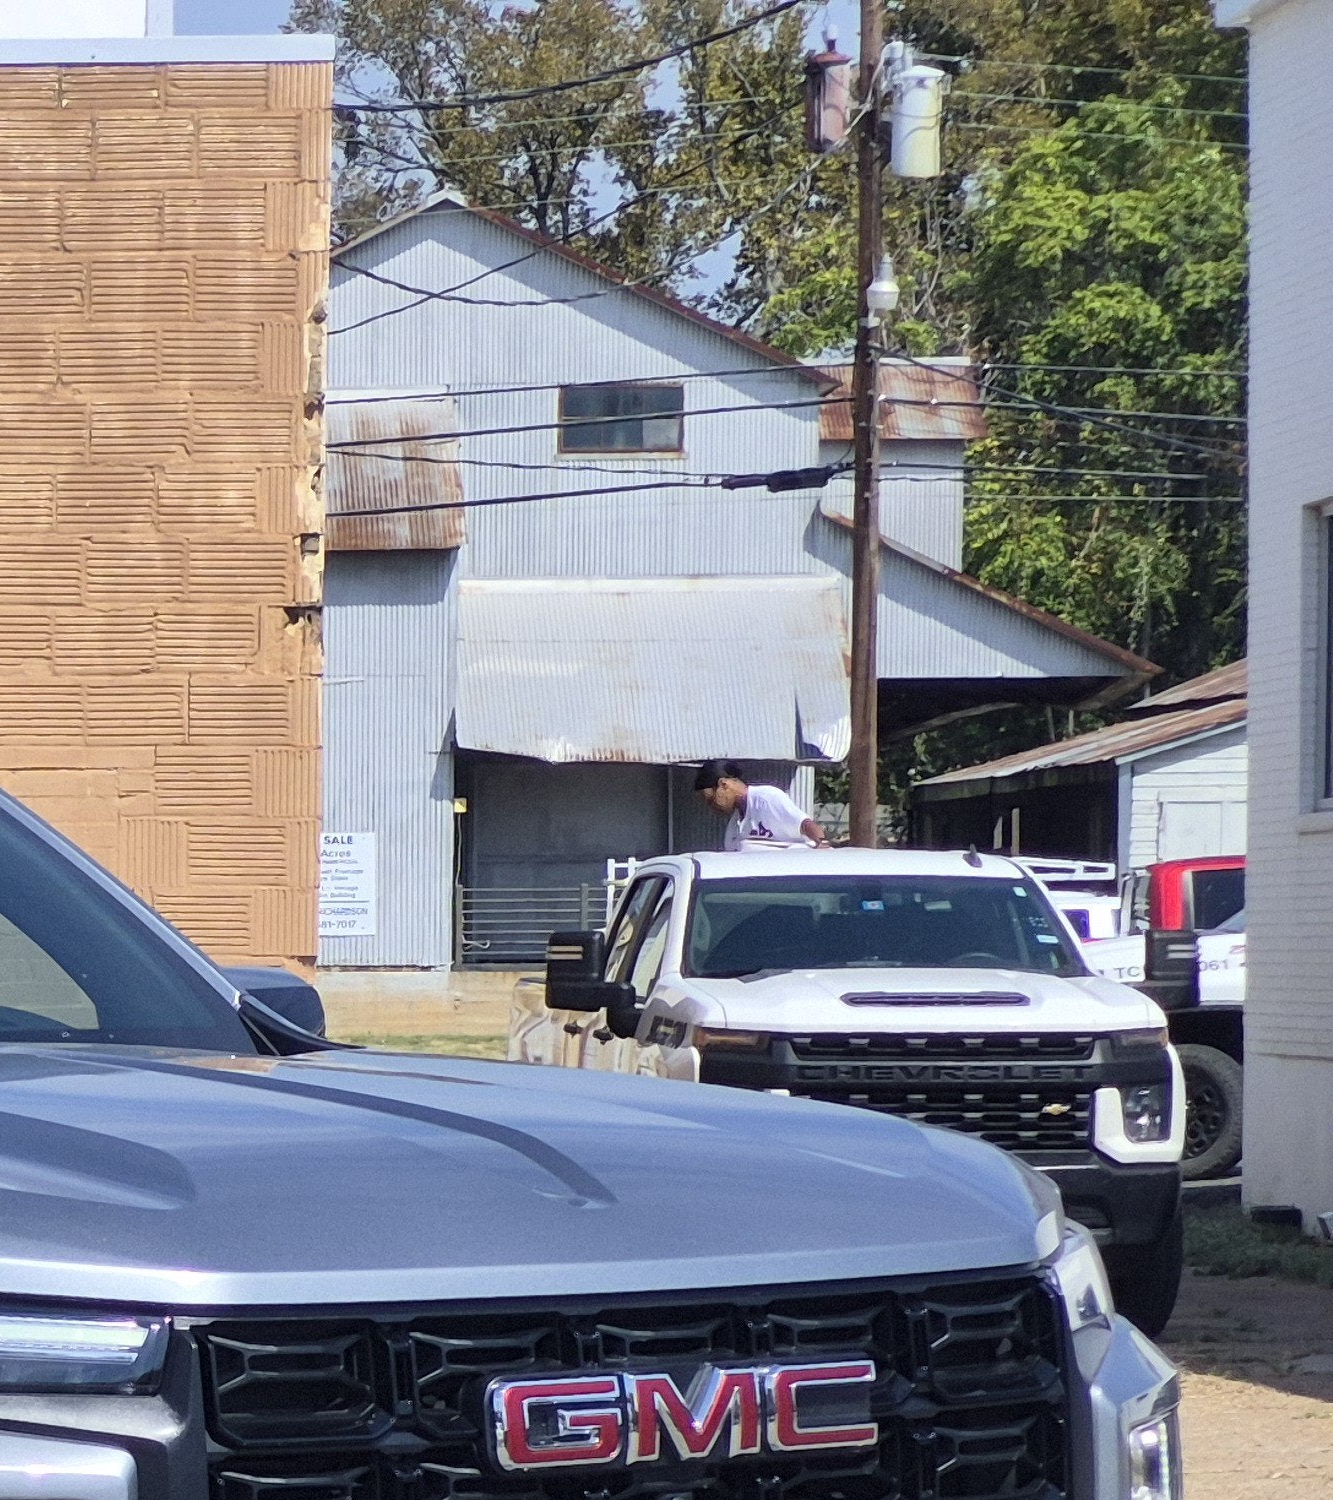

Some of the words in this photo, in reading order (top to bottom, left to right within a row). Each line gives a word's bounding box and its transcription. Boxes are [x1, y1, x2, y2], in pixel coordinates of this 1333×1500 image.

[323, 835, 354, 845] SALE
[321, 849, 352, 858] Acres
[318, 920, 357, 929] 81-7017
[796, 1064, 1093, 1081] CHEVROLET
[489, 1359, 879, 1471] GMC
